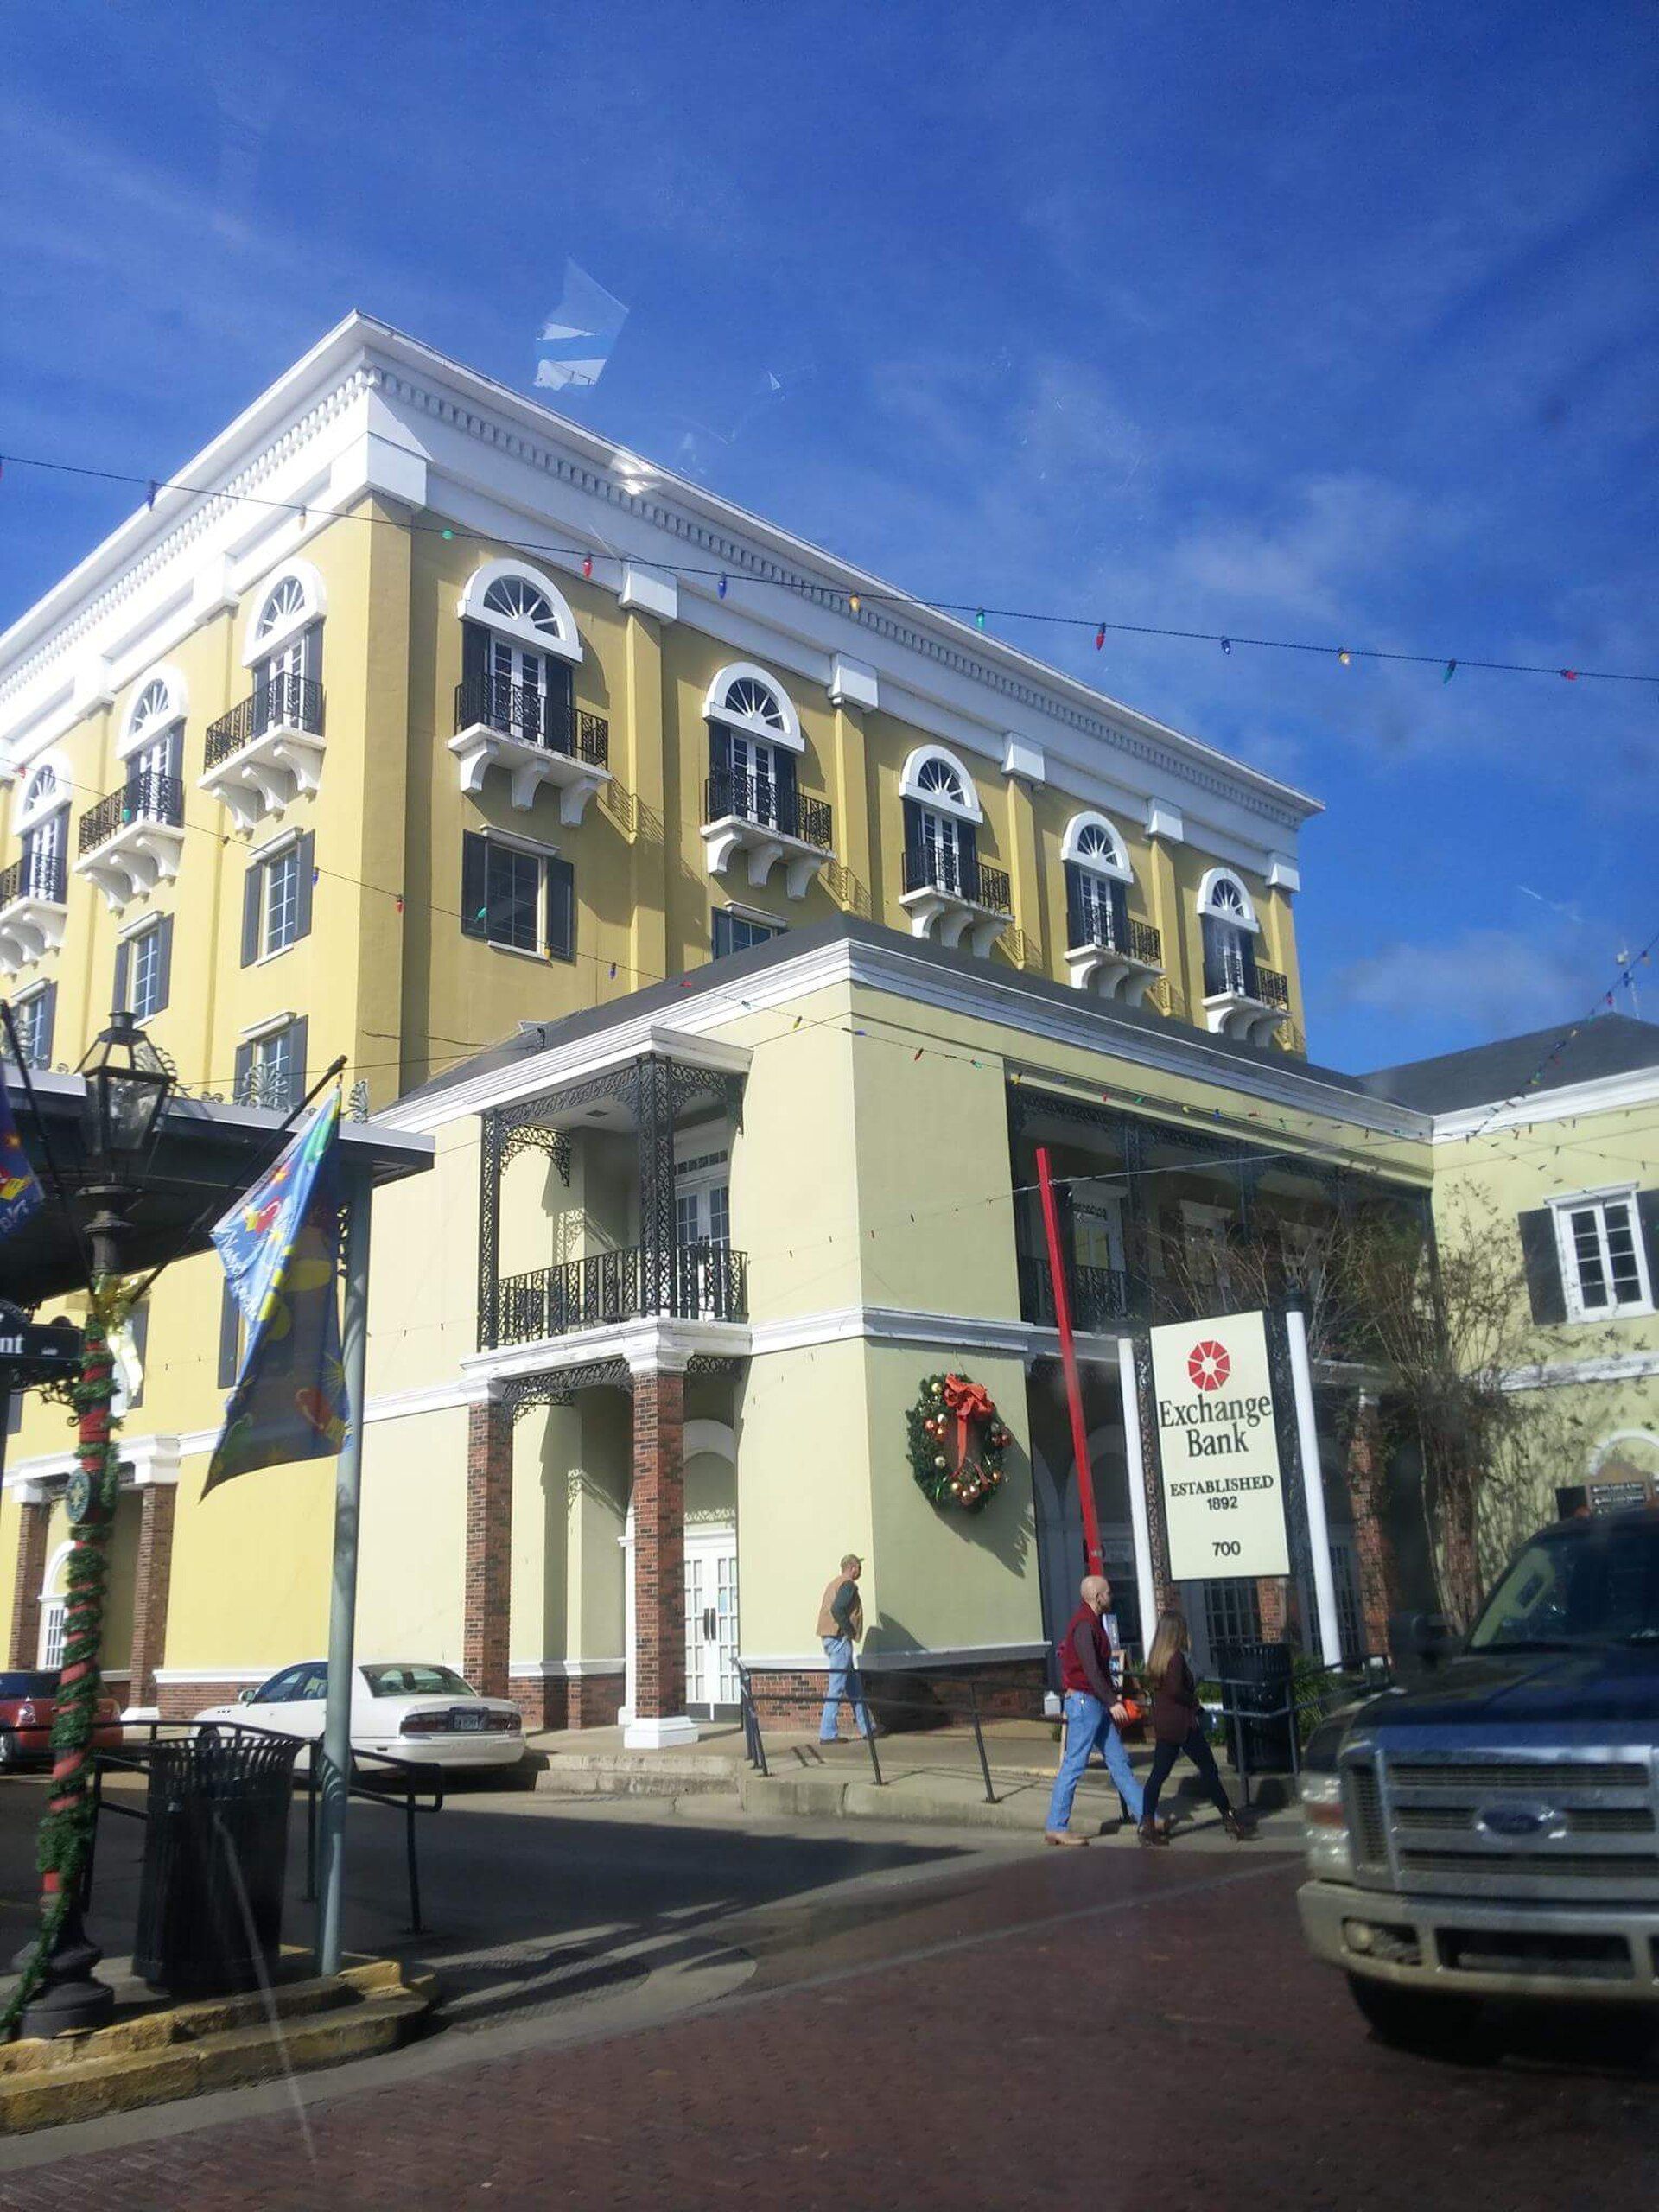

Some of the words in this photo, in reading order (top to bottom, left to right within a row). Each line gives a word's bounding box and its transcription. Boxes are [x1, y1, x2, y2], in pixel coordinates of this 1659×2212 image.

[1159, 1392, 1272, 1427] Exchange
[1186, 1422, 1249, 1458] Bank
[1170, 1474, 1274, 1497] ESTABLISHED
[1206, 1496, 1238, 1510] 1892
[1212, 1541, 1241, 1556] 700
